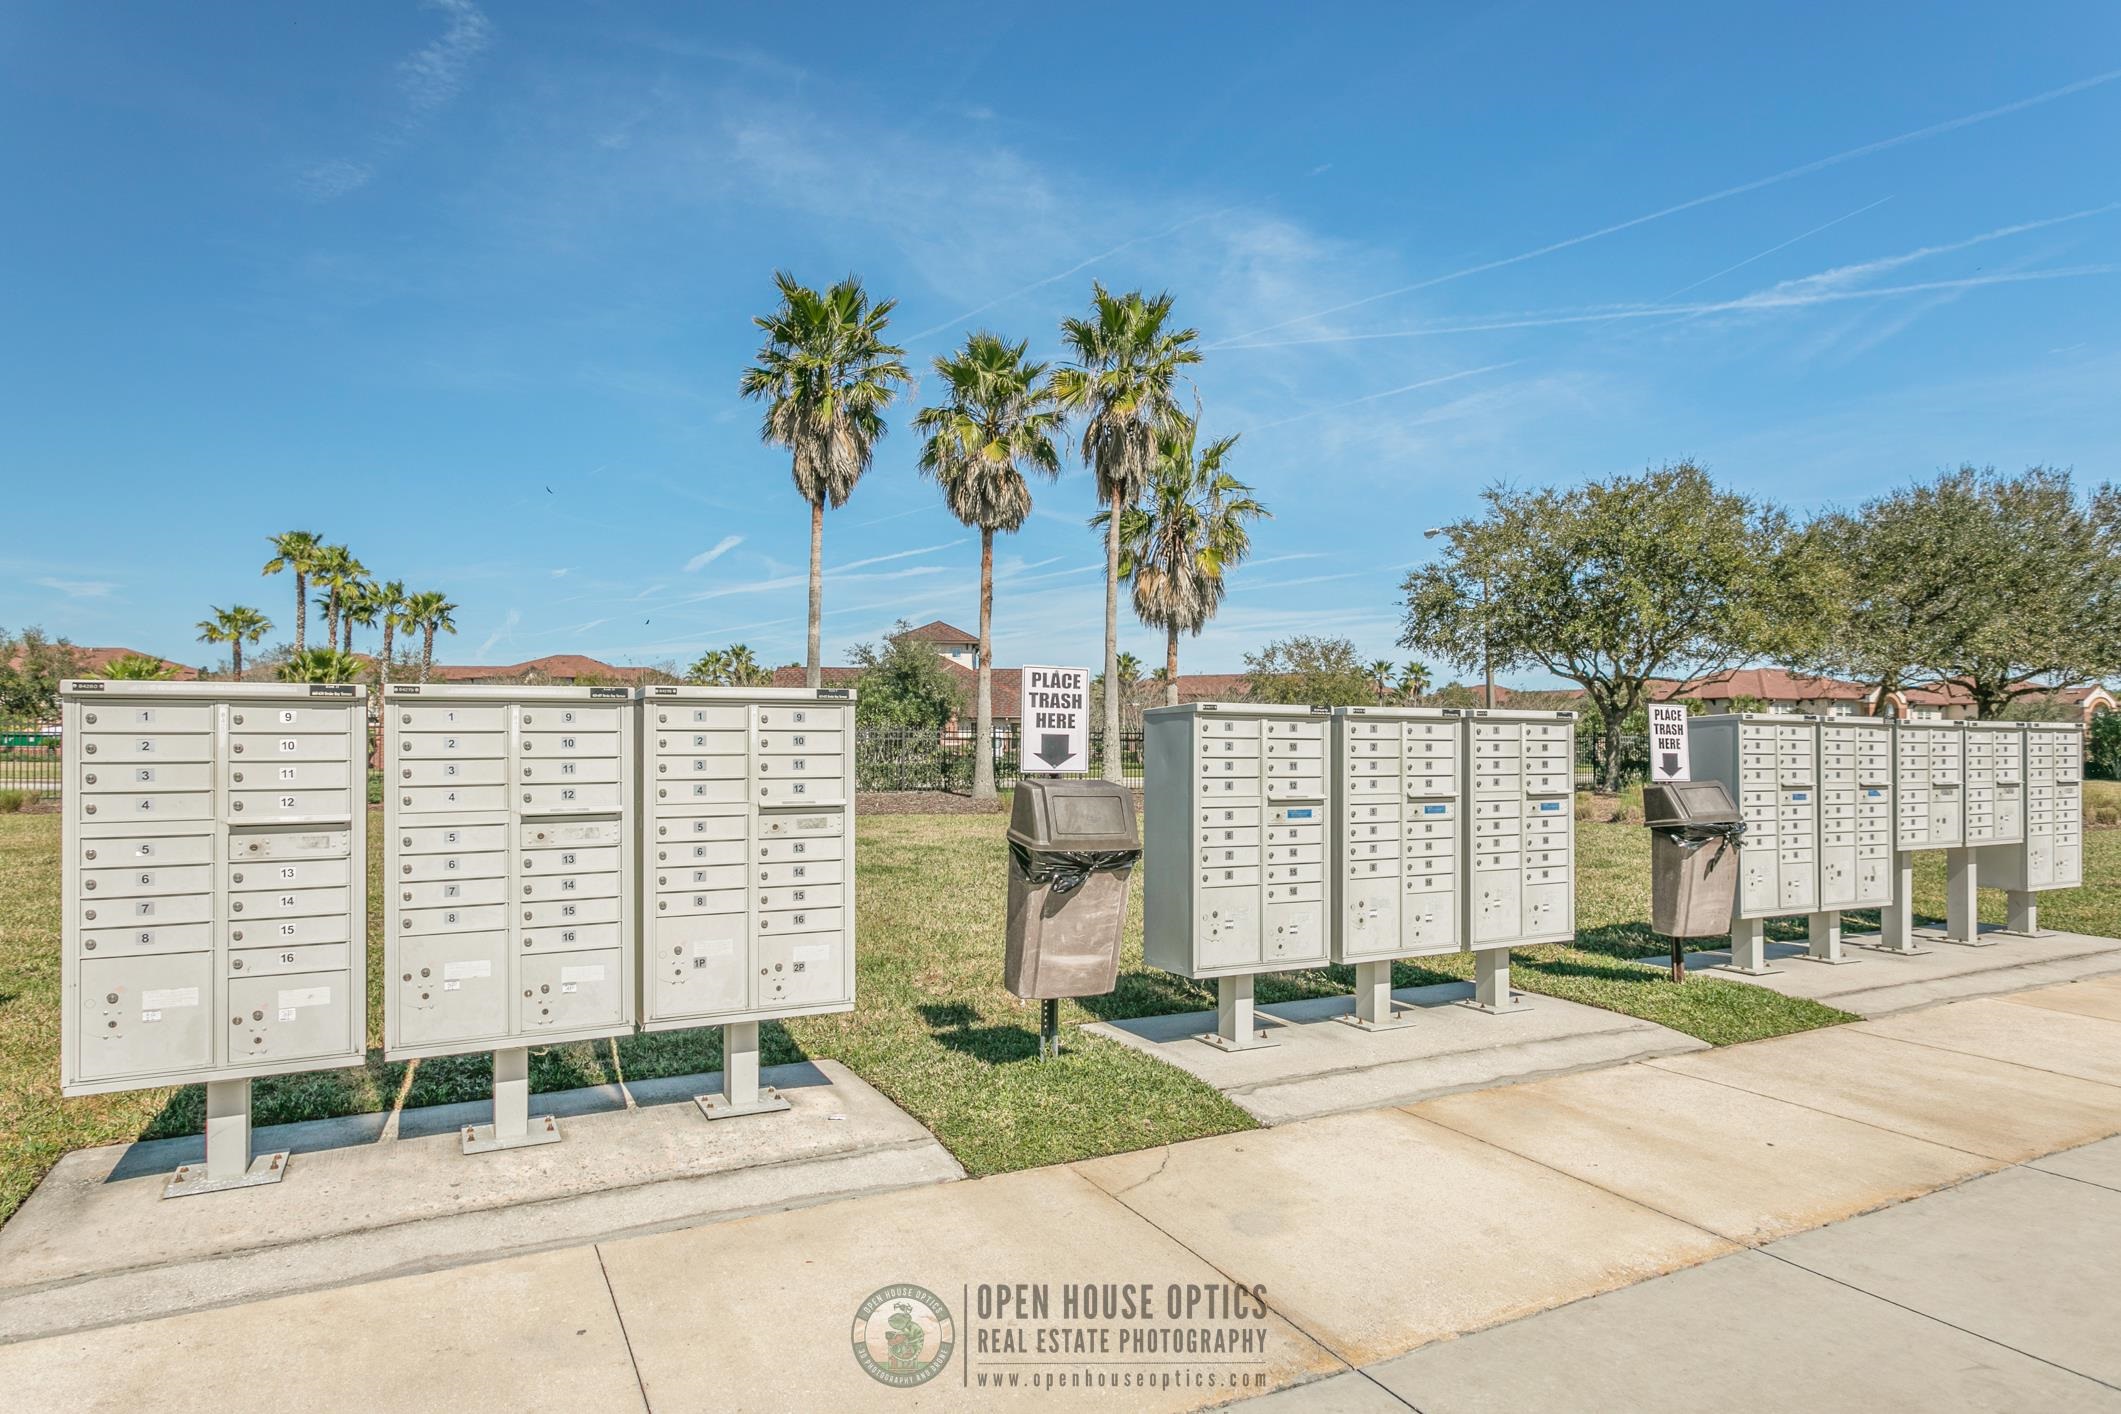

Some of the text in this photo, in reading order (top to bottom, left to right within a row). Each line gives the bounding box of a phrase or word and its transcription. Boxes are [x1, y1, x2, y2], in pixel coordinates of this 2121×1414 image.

[1031, 672, 1081, 689] PLACE
[1028, 692, 1082, 709] TRASH
[142, 711, 149, 721] 1
[285, 712, 292, 722] 9
[448, 712, 454, 721] 1
[565, 712, 572, 722] 9
[697, 711, 703, 721] 1
[796, 713, 803, 722] 9
[1654, 709, 1682, 721] PLACE
[1035, 712, 1076, 729] HERE
[1653, 723, 1684, 736] TRASH
[448, 739, 455, 749] 2
[562, 738, 575, 748] 10
[697, 736, 704, 746] 2
[793, 736, 805, 745] 10
[1658, 738, 1681, 750] HERE
[141, 741, 150, 751] 2
[281, 741, 295, 751] 10
[562, 764, 574, 774] 11
[697, 761, 704, 770] 3
[793, 760, 804, 769] 11
[281, 769, 294, 779] 11
[448, 765, 455, 775] 3
[141, 770, 150, 781] 3
[696, 786, 704, 795] 4
[793, 784, 805, 793] 12
[448, 792, 456, 802] 4
[562, 790, 575, 800] 12
[140, 800, 151, 810] 4
[281, 797, 295, 807] 12
[697, 822, 704, 832] 5
[448, 833, 456, 842] 5
[141, 844, 150, 855] 5
[696, 847, 703, 856] 6
[793, 843, 805, 853] 13
[448, 859, 456, 869] 6
[563, 854, 575, 864] 13
[280, 868, 295, 878] 13
[697, 872, 703, 881] 7
[794, 867, 804, 877] 14
[141, 874, 150, 884] 6
[563, 880, 575, 890] 14
[448, 886, 456, 896] 7
[793, 890, 805, 901] 15
[281, 896, 295, 906] 14
[697, 897, 703, 906] 8
[141, 903, 150, 914] 7
[563, 906, 575, 916] 15
[448, 913, 456, 923] 8
[793, 915, 805, 925] 16
[280, 925, 295, 935] 15
[141, 933, 150, 944] 8
[562, 932, 575, 942] 16
[280, 953, 294, 963] 16
[694, 958, 706, 968] 1P
[793, 962, 805, 974] 2P
